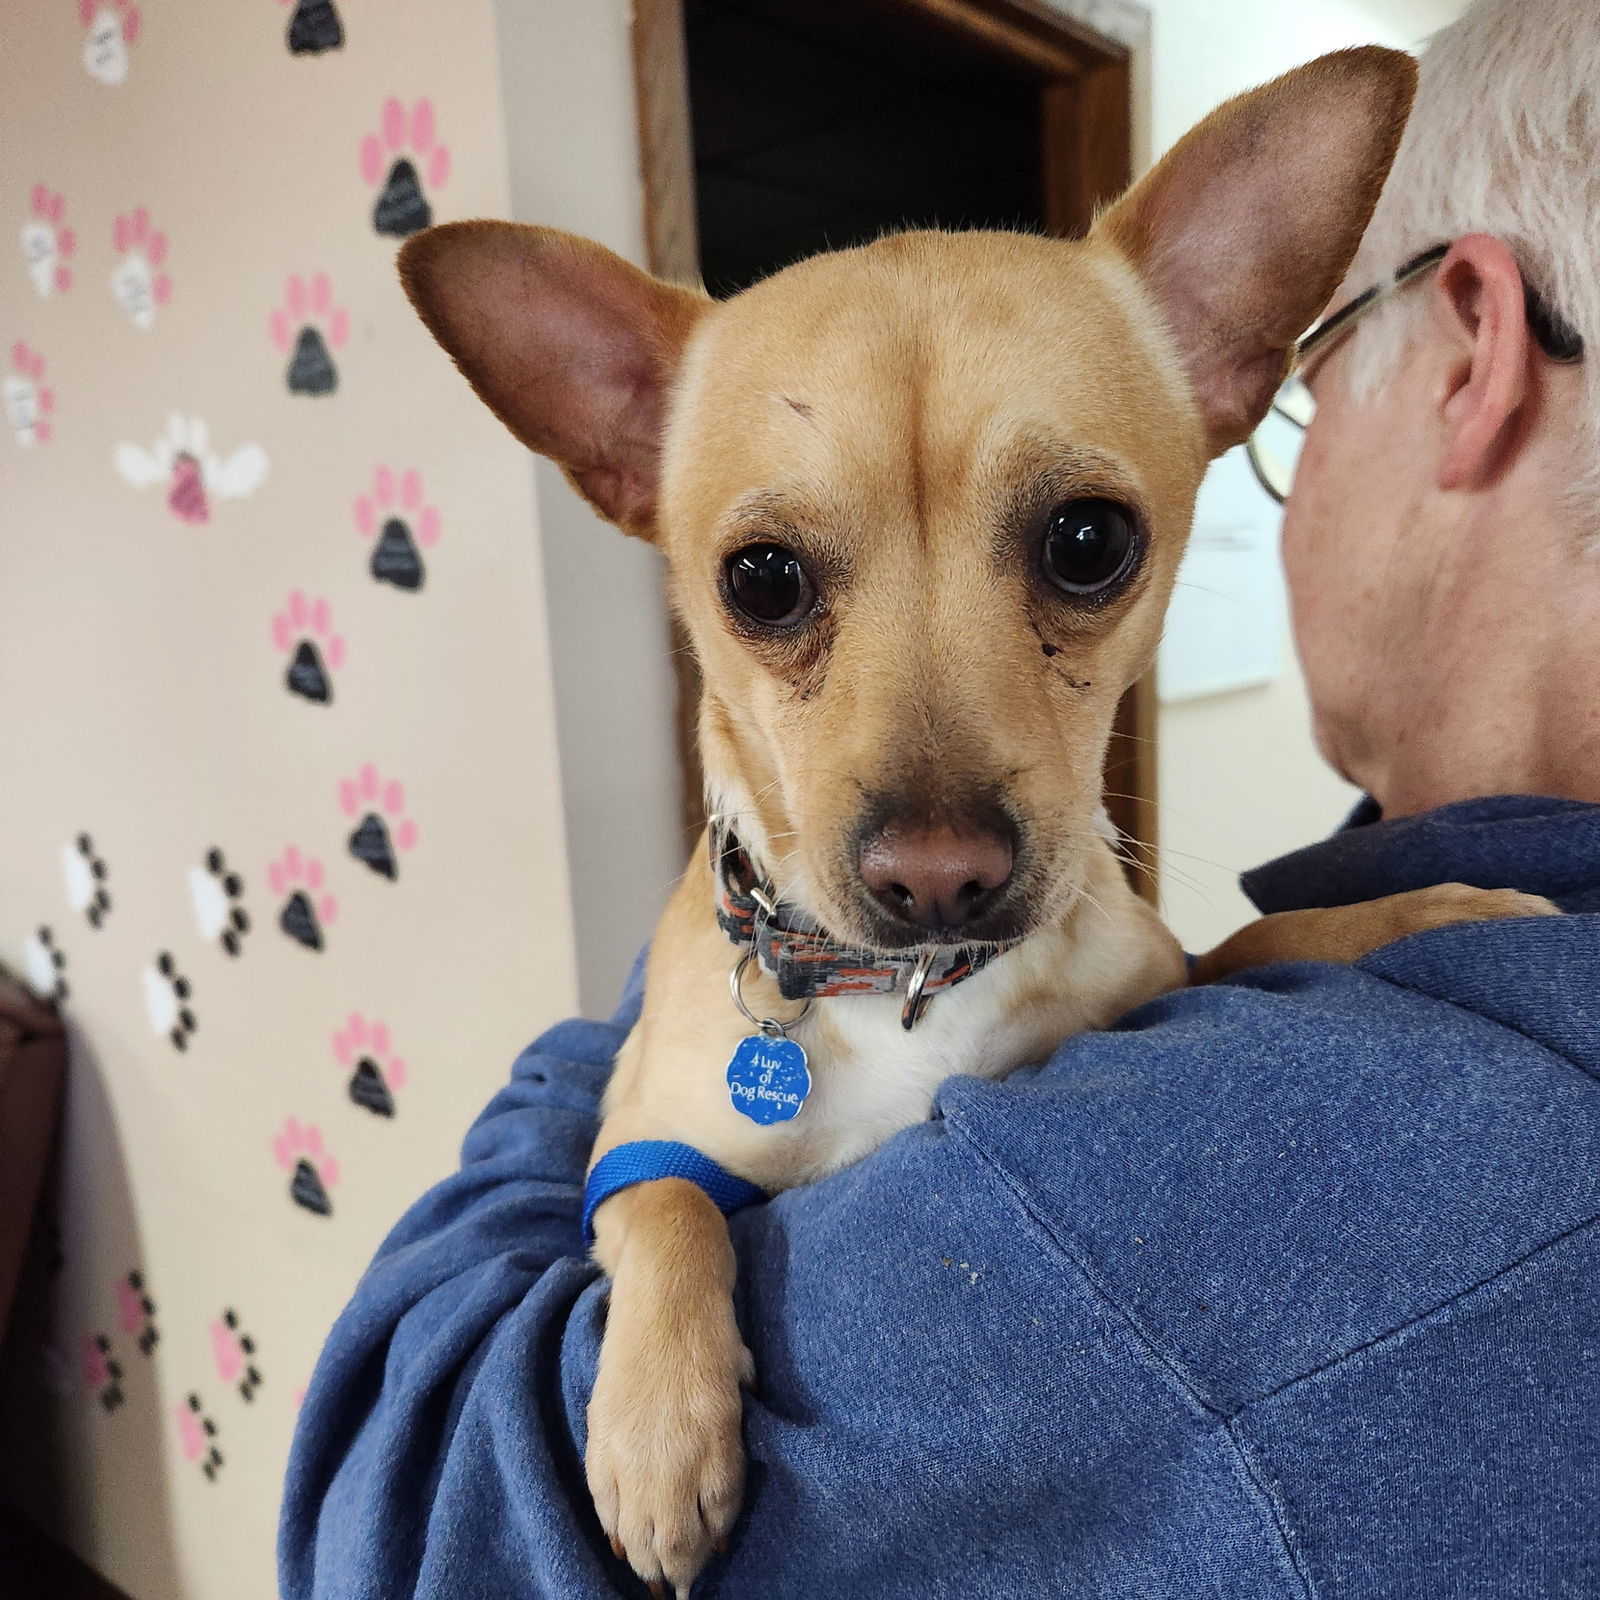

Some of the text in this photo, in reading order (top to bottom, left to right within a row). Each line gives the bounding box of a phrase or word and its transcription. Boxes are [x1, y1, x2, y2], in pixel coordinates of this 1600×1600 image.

[751, 1051, 782, 1069] 4 Luv
[759, 1069, 773, 1084] of
[731, 1082, 799, 1103] Dog Rescue
